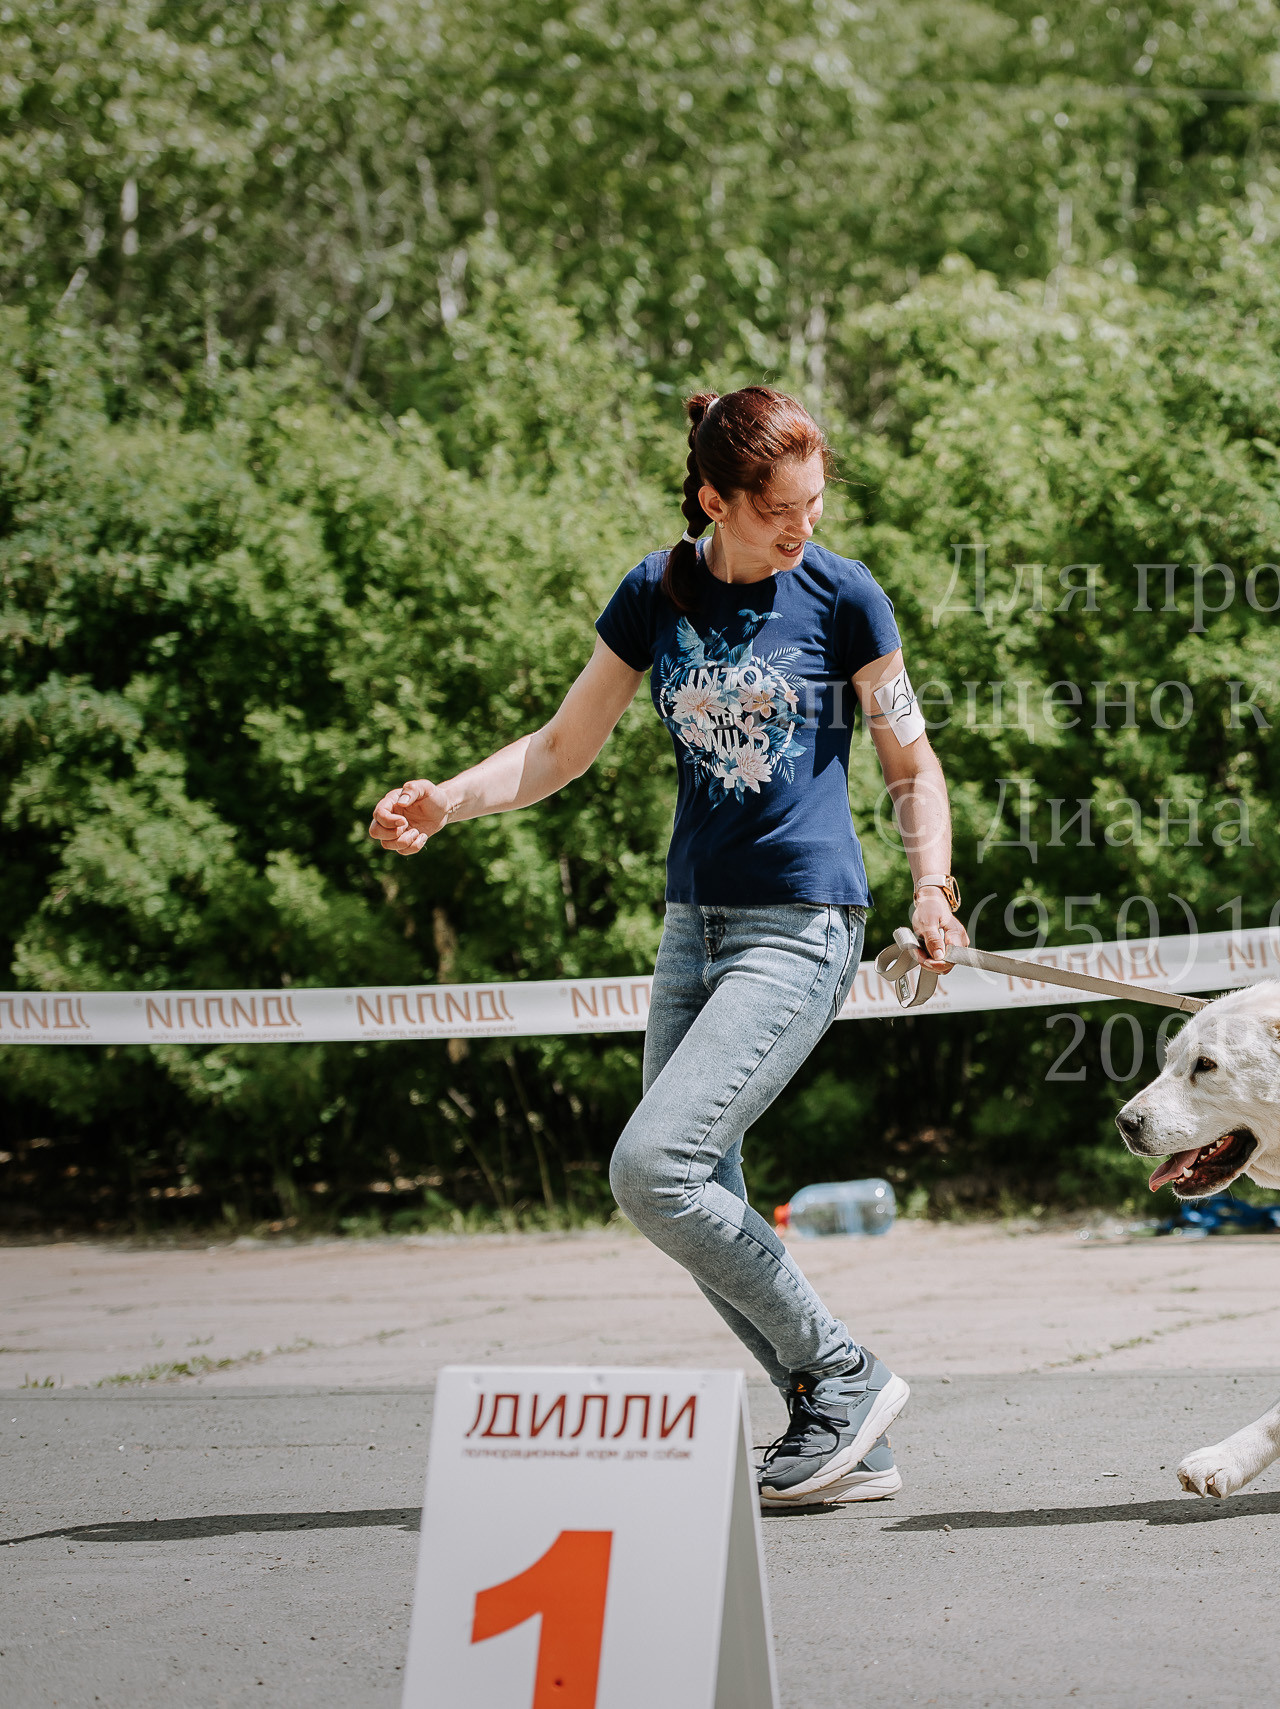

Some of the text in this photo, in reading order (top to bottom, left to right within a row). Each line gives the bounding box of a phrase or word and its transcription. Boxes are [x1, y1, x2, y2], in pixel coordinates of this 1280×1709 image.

[687, 666, 764, 691] INTO
[711, 713, 743, 727] THE
[700, 729, 770, 754] WILD
[464, 1392, 697, 1439] ДИЛЛИ
[470, 1530, 614, 1709] 1
